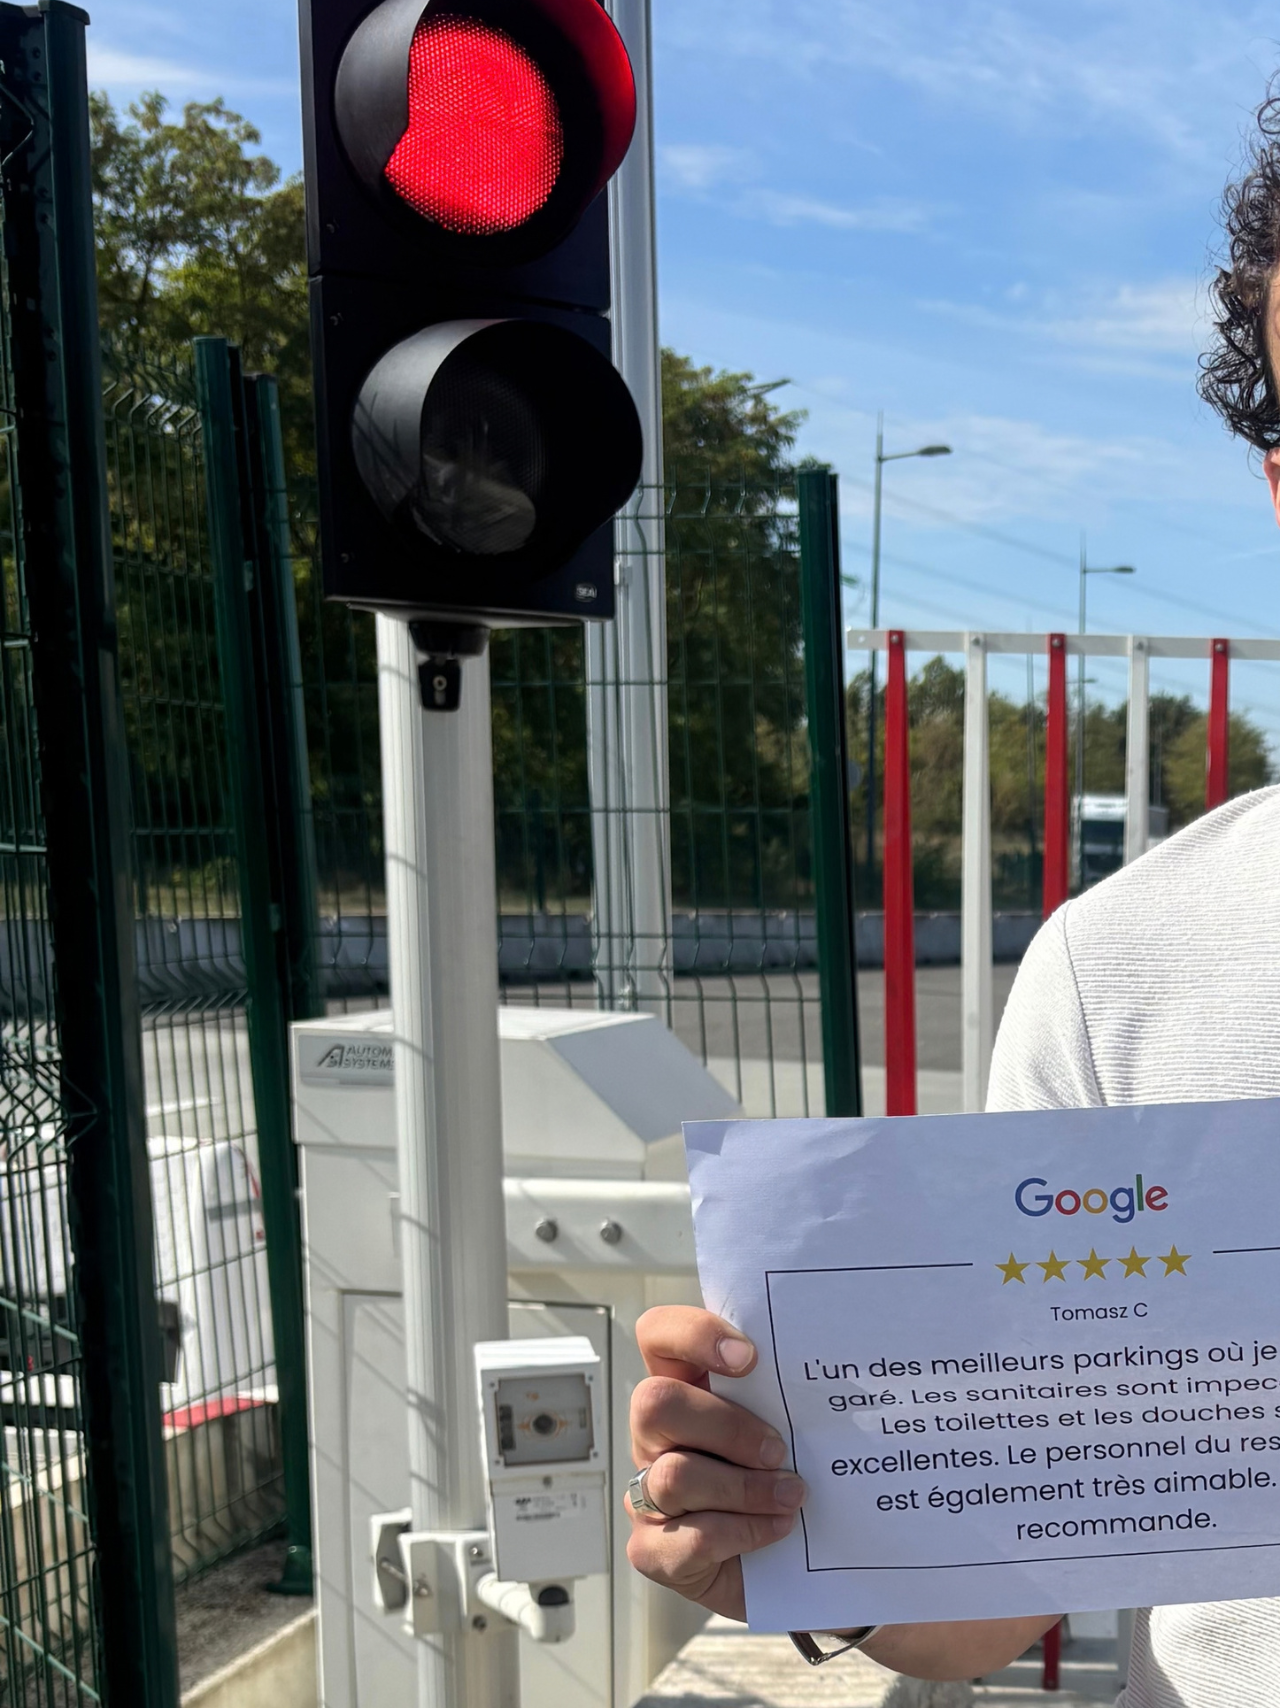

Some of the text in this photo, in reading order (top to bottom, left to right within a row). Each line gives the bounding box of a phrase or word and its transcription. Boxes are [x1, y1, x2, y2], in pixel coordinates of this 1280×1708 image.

[346, 1045, 393, 1057] AUTOM
[1014, 1173, 1169, 1224] Google
[1049, 1302, 1148, 1323] Tomasz C
[804, 1358, 860, 1381] L'un
[868, 1357, 922, 1378] des
[931, 1352, 1065, 1375] meilleurs
[1073, 1345, 1199, 1375] parkings
[1207, 1341, 1244, 1363] où
[1251, 1340, 1278, 1367] je
[828, 1389, 904, 1412] garé.
[911, 1389, 958, 1404] Les
[966, 1381, 1108, 1402] sanitaires
[1116, 1378, 1179, 1397] sont
[881, 1417, 927, 1435] Les
[934, 1412, 1050, 1432] toilettes
[1058, 1409, 1086, 1427] et
[1094, 1408, 1133, 1426] les
[1141, 1403, 1265, 1424] douches
[831, 1448, 1000, 1477] excellentes.
[1007, 1444, 1037, 1465] Le
[1045, 1435, 1186, 1470] personnel
[1194, 1434, 1231, 1455] du
[876, 1489, 920, 1512] est
[927, 1478, 1085, 1514] également
[1091, 1473, 1146, 1498] très
[1153, 1466, 1277, 1494] aimable.
[1016, 1508, 1217, 1541] recommande.
